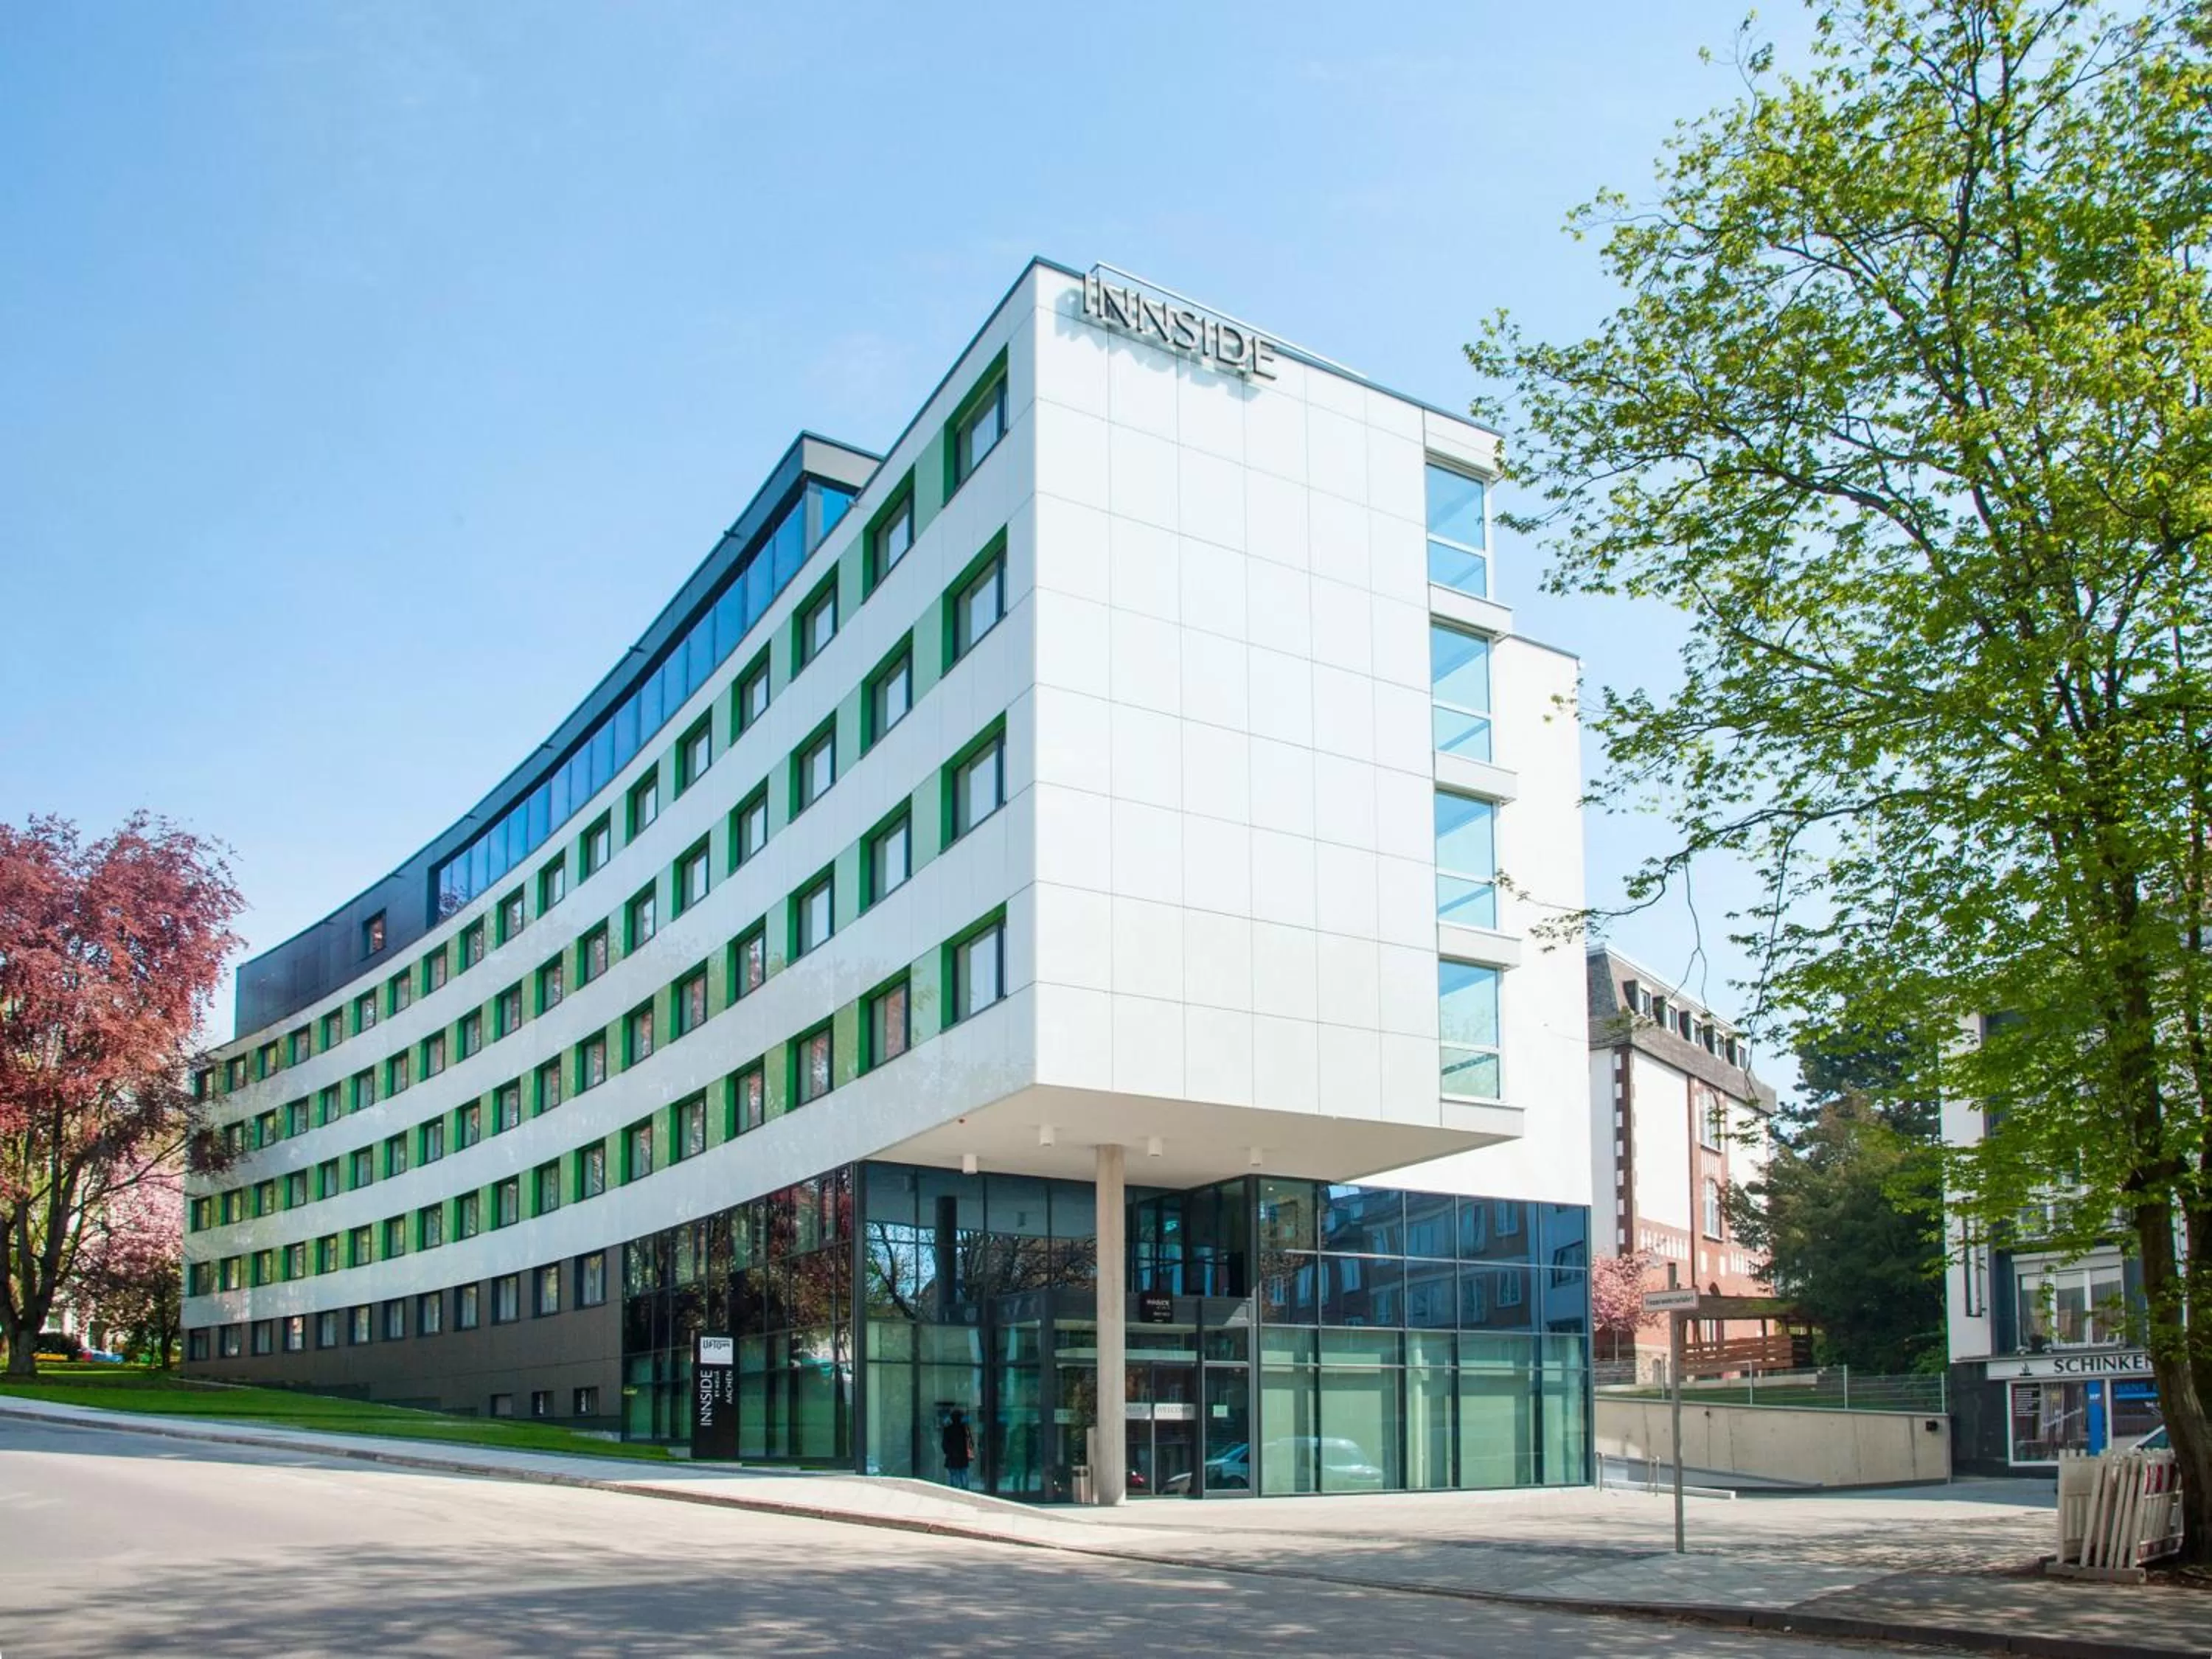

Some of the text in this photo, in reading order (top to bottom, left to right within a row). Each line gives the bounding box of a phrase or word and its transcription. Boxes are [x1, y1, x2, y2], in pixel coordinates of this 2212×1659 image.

[1083, 271, 1279, 380] INNSIDE
[700, 1369, 713, 1427] INNSIDE
[725, 1370, 733, 1405] AACHEN
